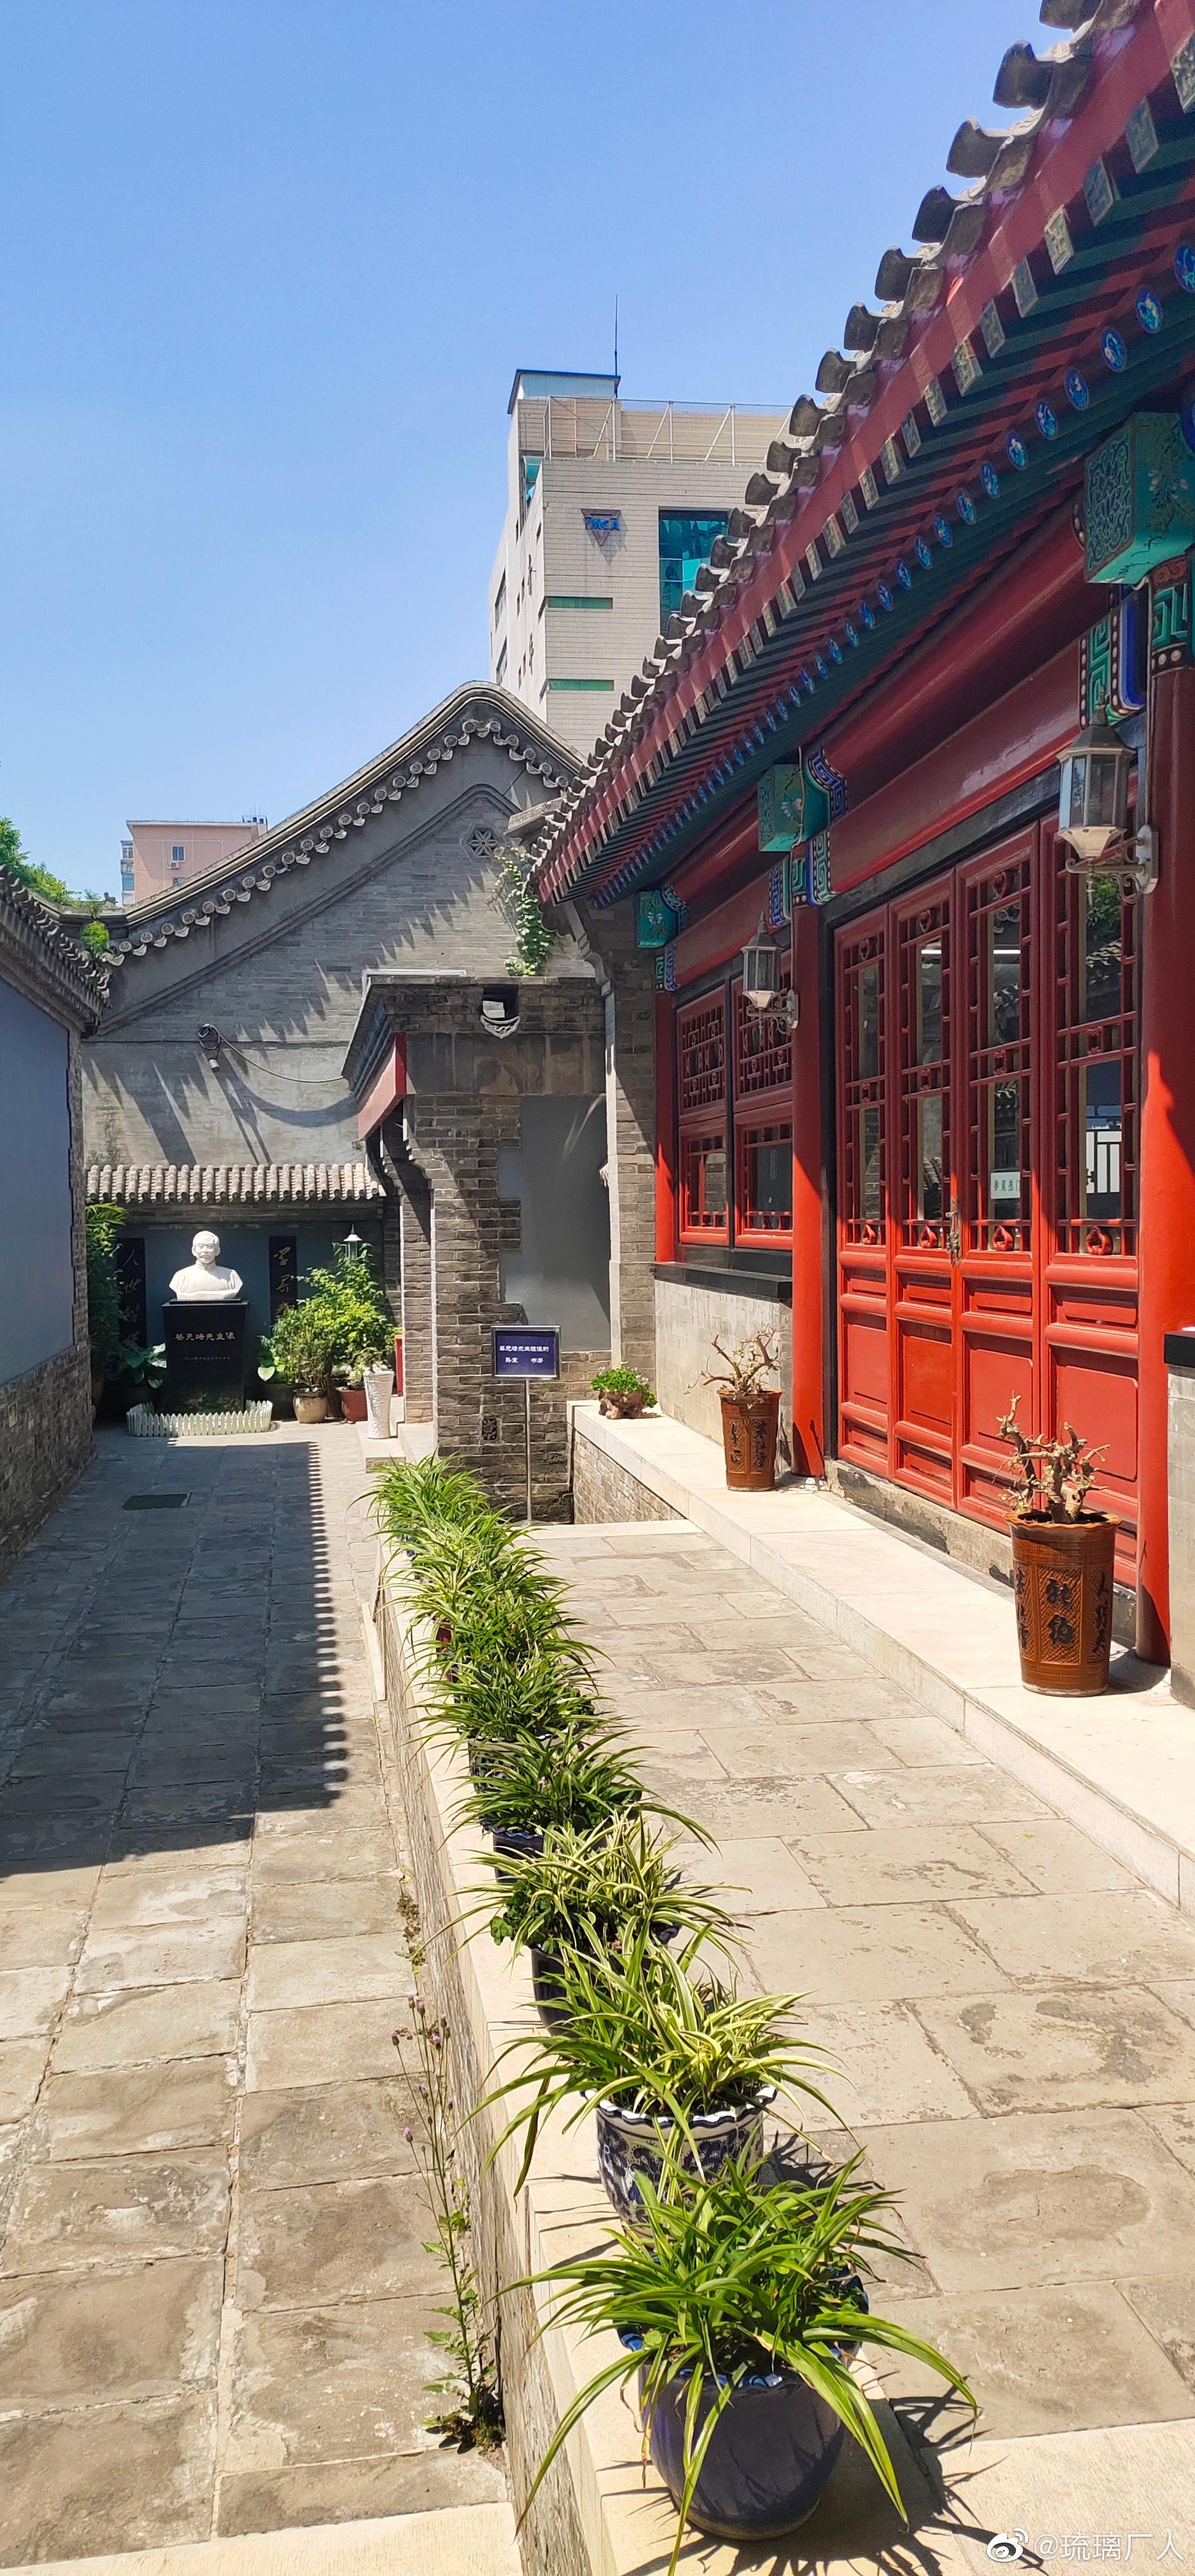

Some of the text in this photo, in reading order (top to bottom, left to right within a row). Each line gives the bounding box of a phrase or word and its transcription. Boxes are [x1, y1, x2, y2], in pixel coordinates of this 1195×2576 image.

[175, 1332, 236, 1341] 蔡元培先生像
